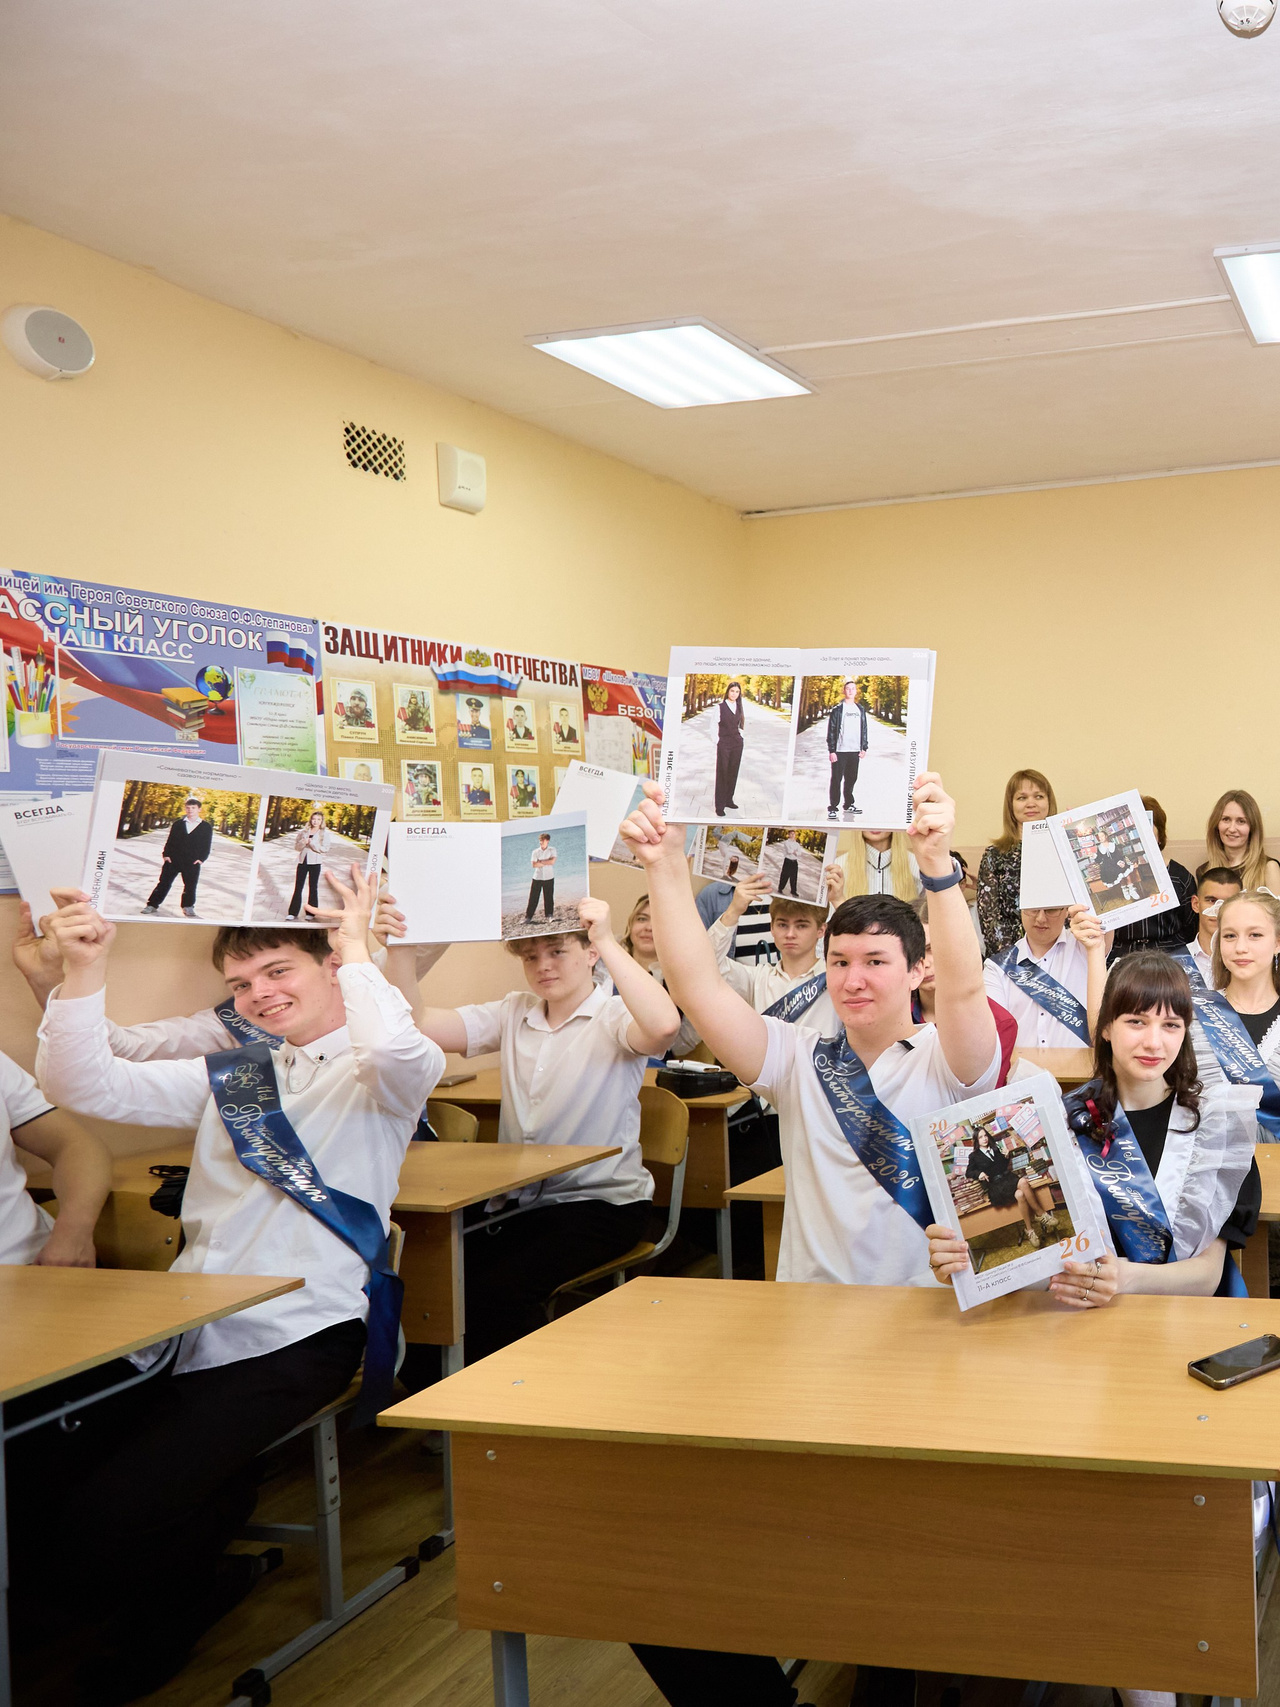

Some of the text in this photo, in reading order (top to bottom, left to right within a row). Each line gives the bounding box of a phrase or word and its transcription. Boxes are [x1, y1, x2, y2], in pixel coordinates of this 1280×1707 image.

[44, 581, 68, 597] им.
[71, 583, 112, 604] Героя
[115, 590, 187, 615] Советского
[190, 603, 228, 622] Союза
[230, 610, 314, 634] Ф.Ф.Степанова»
[43, 624, 194, 660] НАШ КЛАСС
[153, 616, 264, 652] УГОЛОК
[324, 625, 580, 688] ЗАЩИТНИКИ ОТЕЧЕСТВА
[253, 686, 303, 698] ГРАМОТА
[618, 704, 664, 719] БЕЗОП
[579, 765, 604, 776] ВСЕГДА
[14, 805, 64, 820] ВСЕГДА
[1061, 816, 1073, 828] 20
[406, 827, 447, 835] ВСЕГДА
[96, 850, 107, 870] ИВАН
[1150, 890, 1169, 908] 26
[1057, 1011, 1084, 1028] 2026
[1223, 1063, 1250, 1084] 202
[815, 1053, 915, 1151] Выпускник
[929, 1118, 948, 1136] 20
[220, 1103, 327, 1202] Выпускник
[868, 1156, 920, 1190] 2026
[1059, 1230, 1090, 1260] 26
[977, 1275, 1012, 1292] 11-А класс
